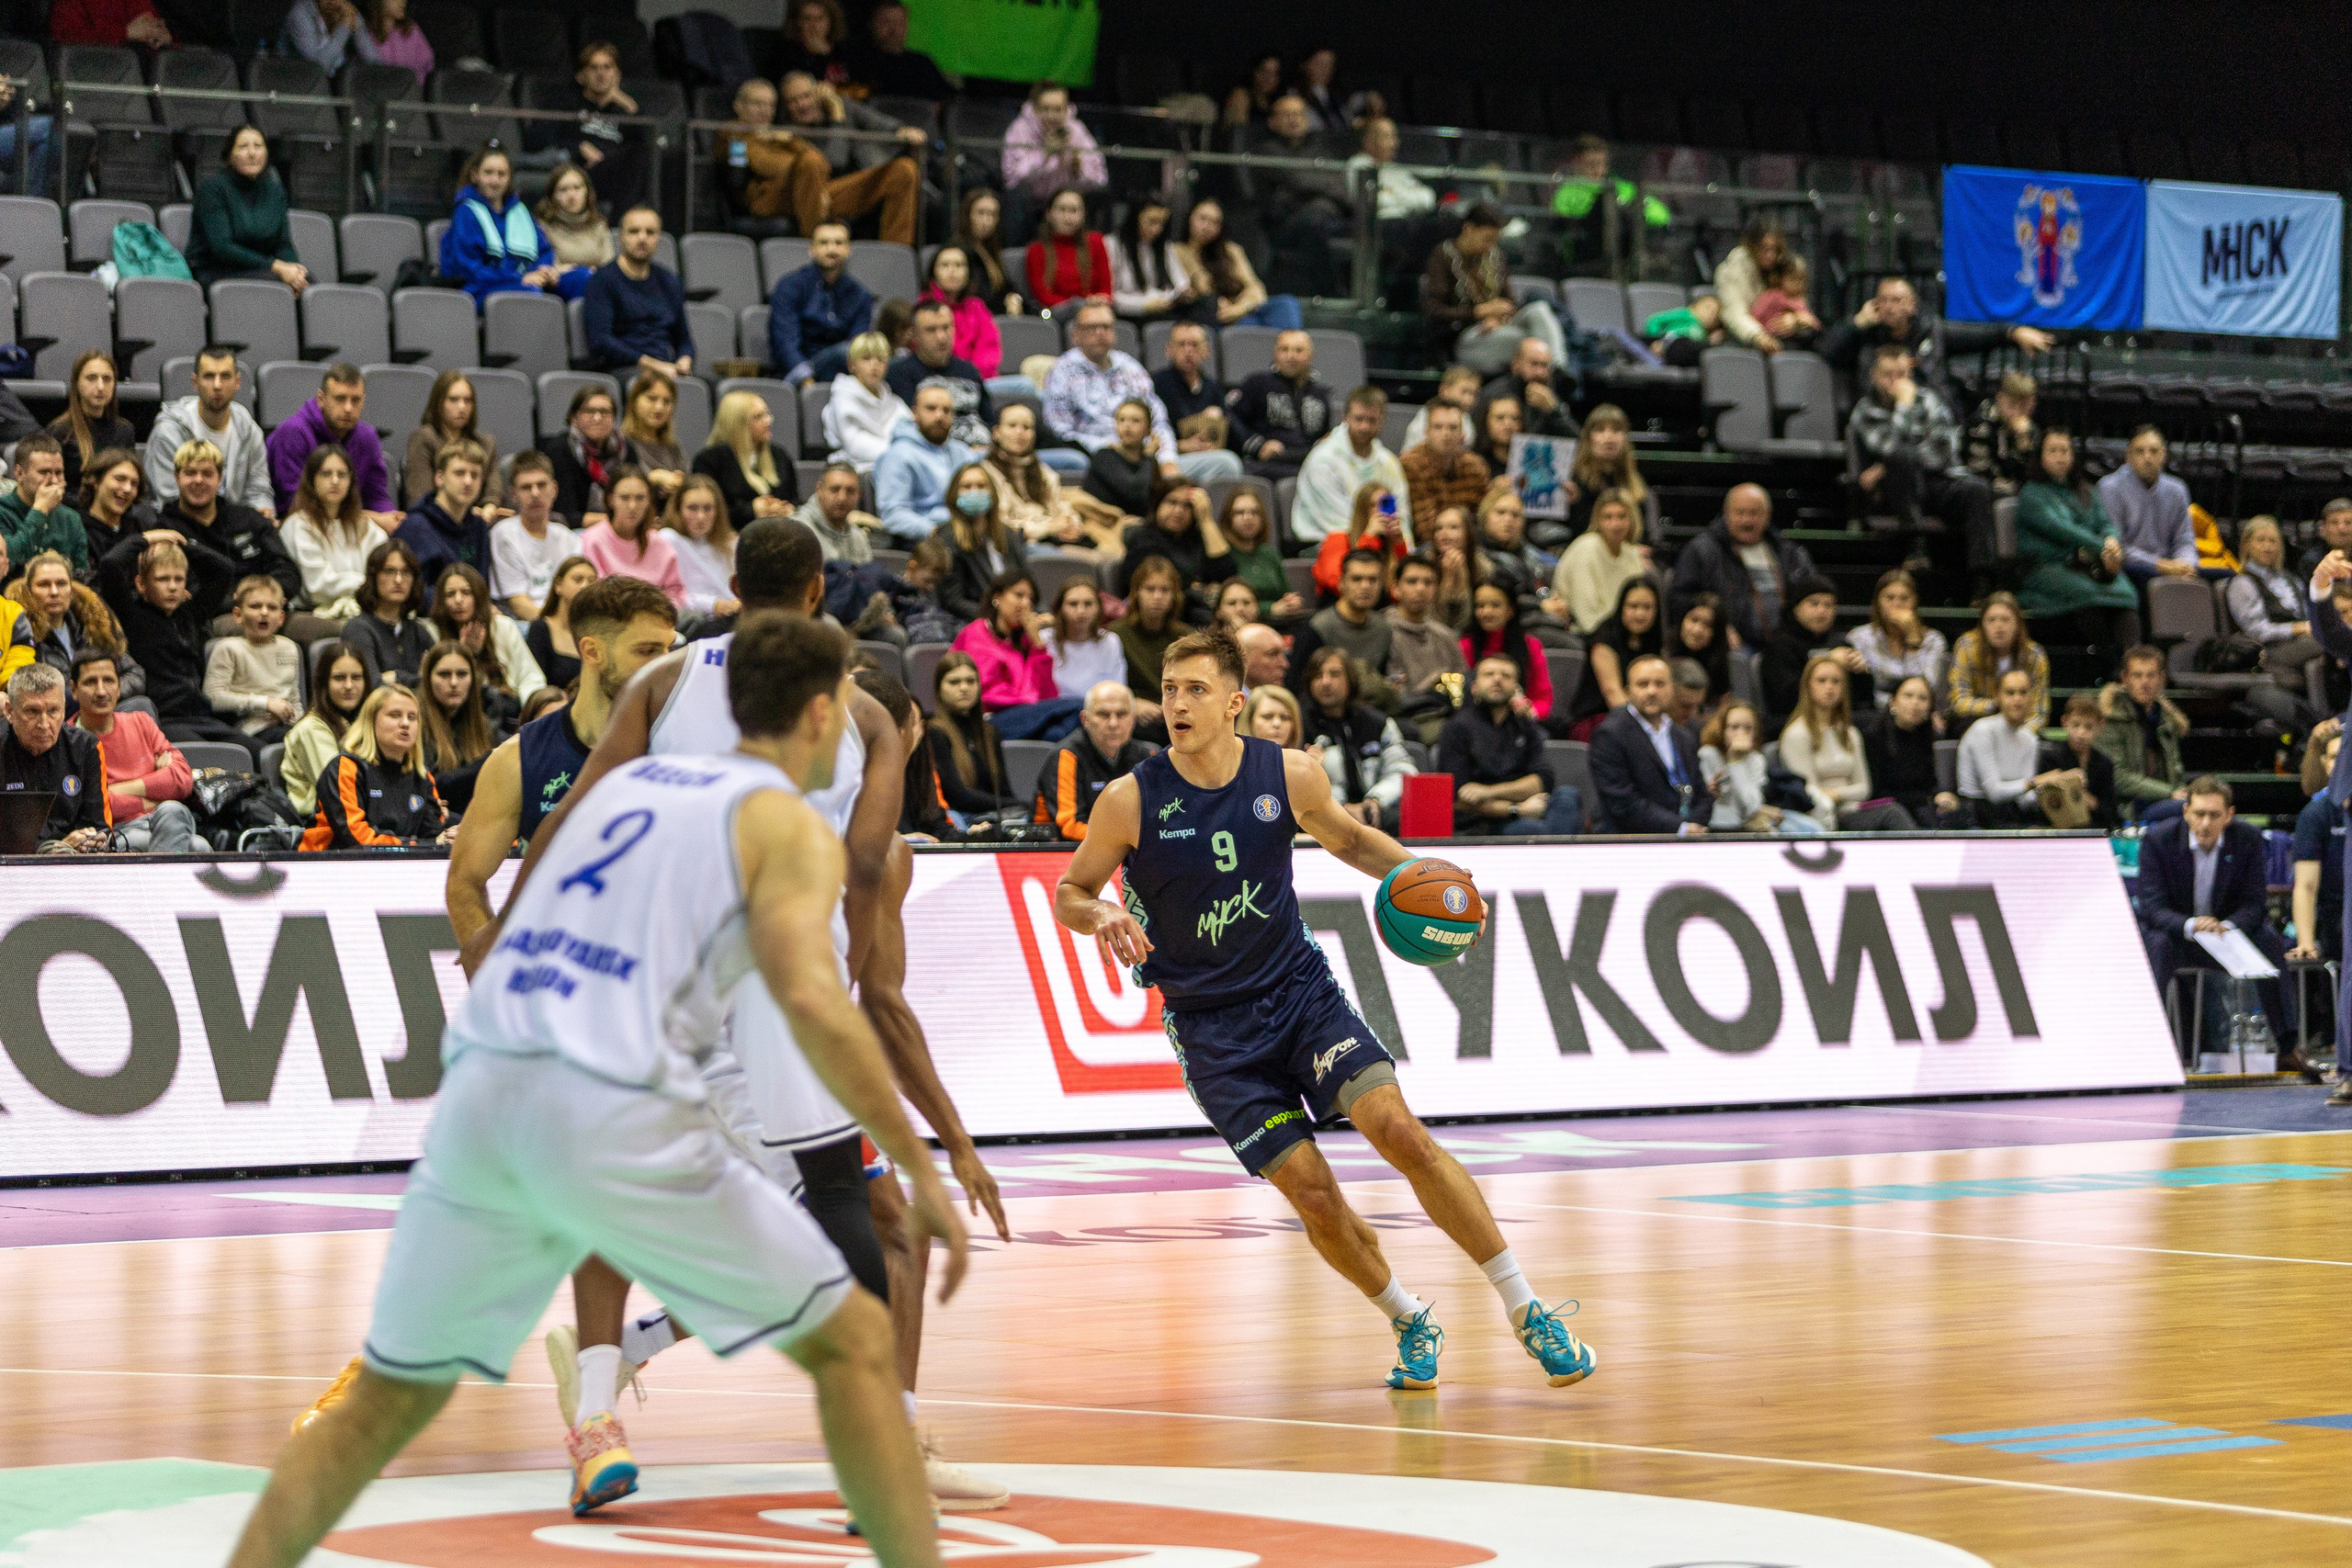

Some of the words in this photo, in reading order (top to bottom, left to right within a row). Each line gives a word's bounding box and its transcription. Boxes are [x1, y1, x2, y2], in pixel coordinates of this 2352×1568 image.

[1159, 828, 1195, 840] Kempa
[1211, 830, 1238, 872] 9
[558, 808, 655, 897] 2
[1421, 925, 1474, 945] SIBUR
[0, 862, 459, 1117] ОЙЛ
[1233, 1127, 1265, 1153] Kempa
